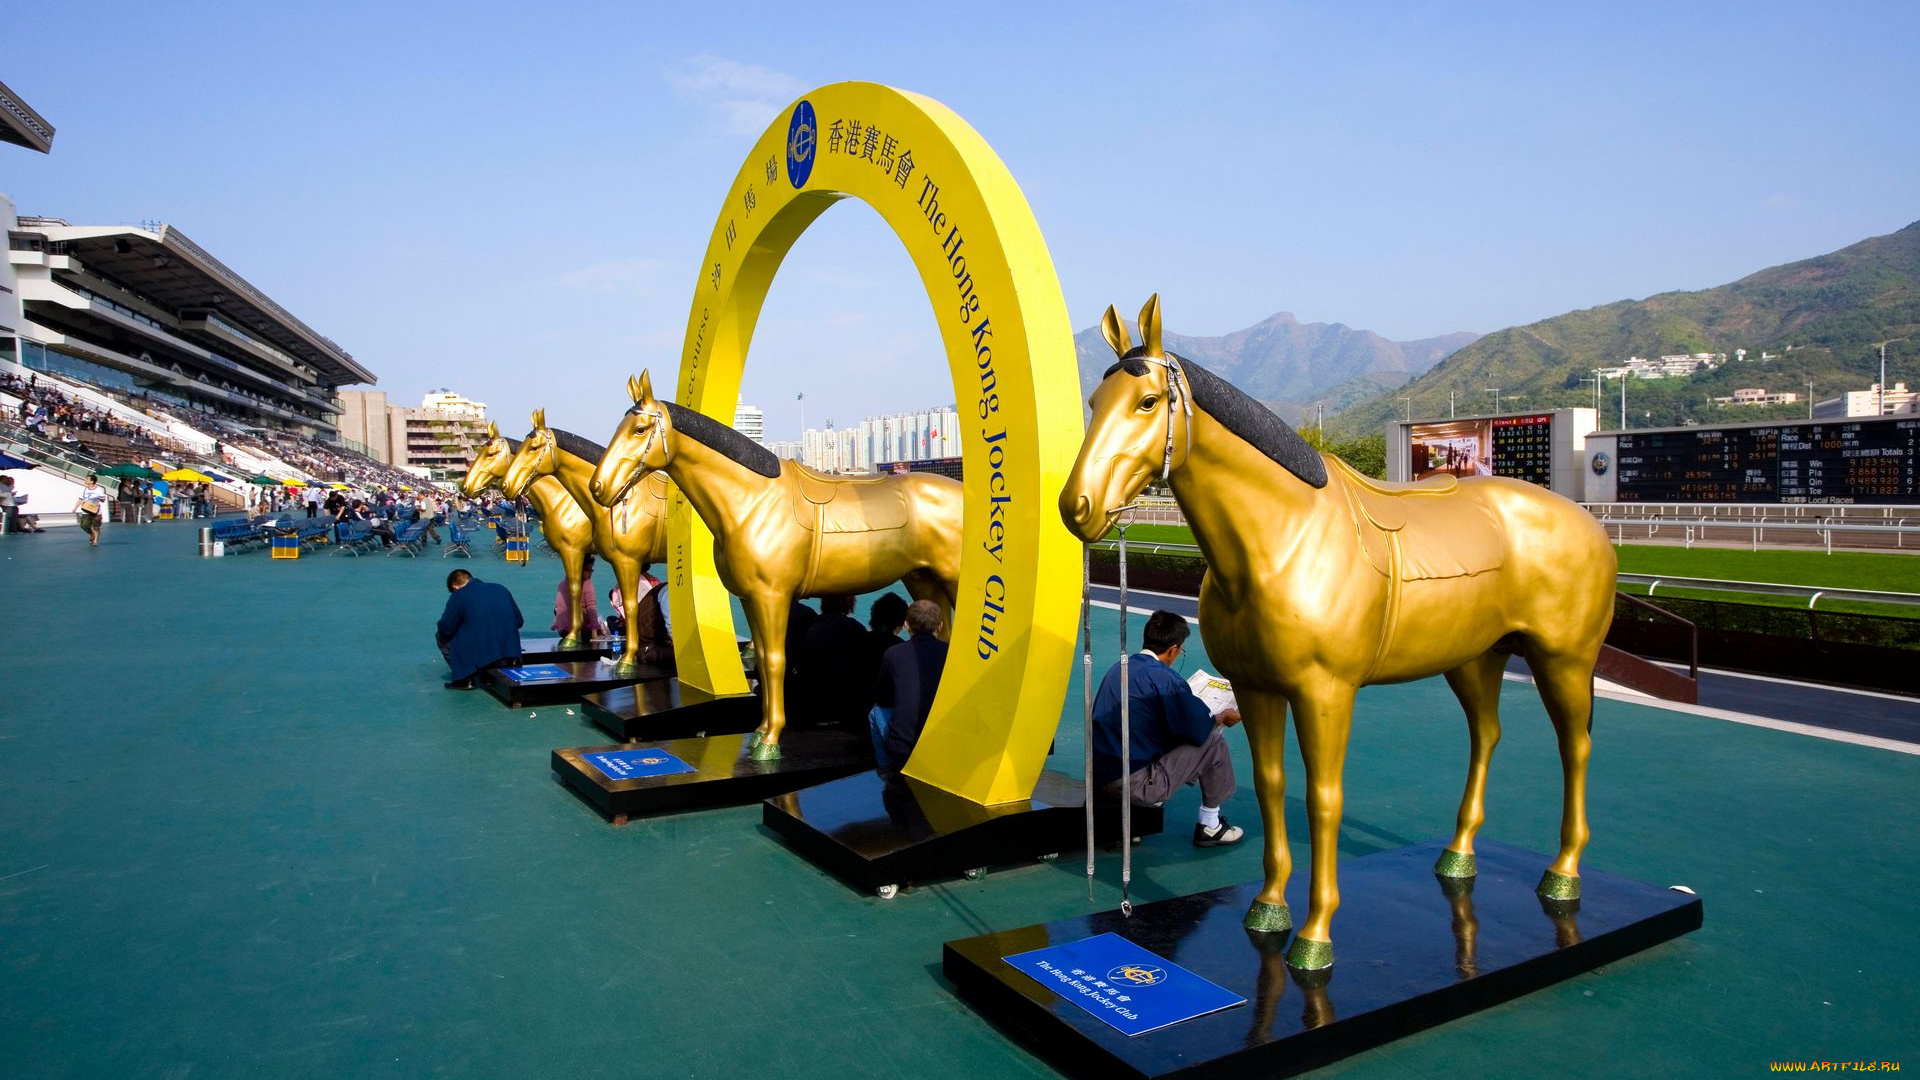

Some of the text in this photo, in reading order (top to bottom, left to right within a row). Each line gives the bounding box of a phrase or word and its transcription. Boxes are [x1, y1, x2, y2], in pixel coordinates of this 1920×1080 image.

[828, 118, 1012, 660] 香港賽馬會 The Hong Kong Jockey Club
[1036, 960, 1139, 1020] The Hong Kong Jockey Club
